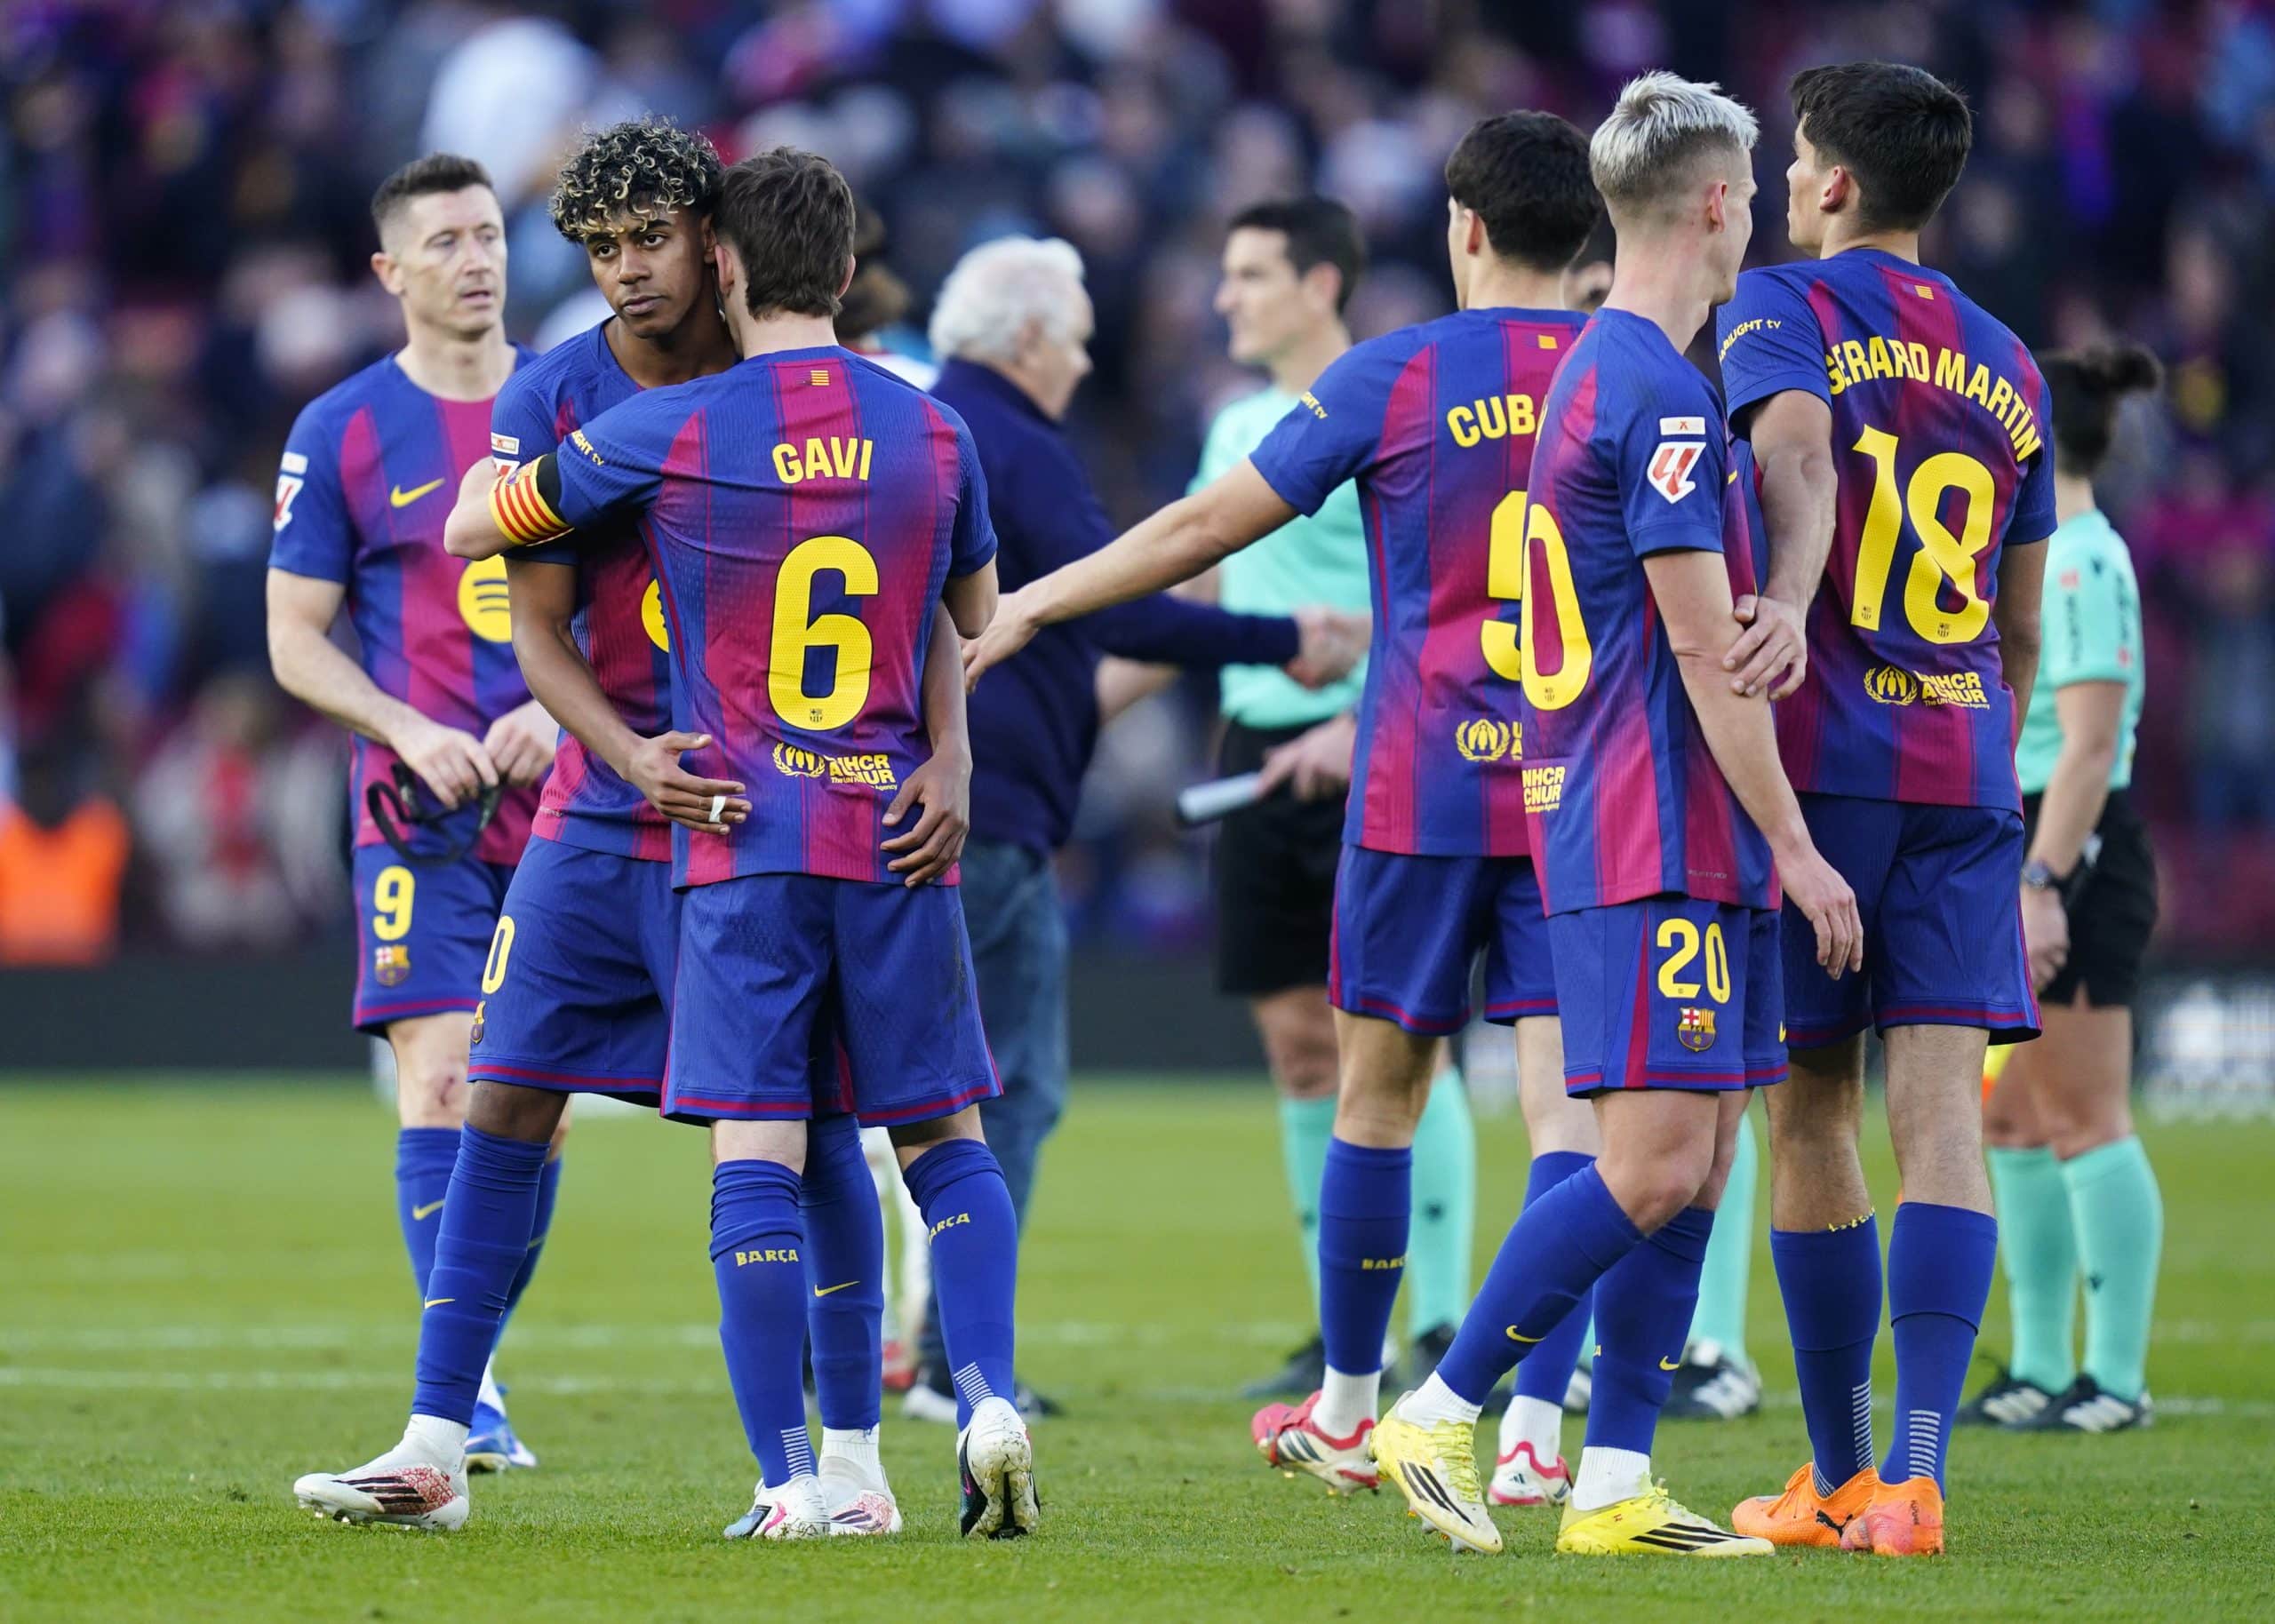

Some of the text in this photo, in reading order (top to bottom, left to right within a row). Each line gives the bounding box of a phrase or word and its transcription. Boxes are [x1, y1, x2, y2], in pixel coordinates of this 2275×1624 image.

[1766, 318, 1782, 330] tv
[1825, 335, 1931, 395] GERARD
[1446, 394, 1548, 448] CUB
[771, 436, 874, 484] GAVI
[1849, 423, 1996, 645] 18
[767, 535, 880, 731] 6
[372, 865, 416, 941] 9
[481, 914, 515, 995] 0
[1656, 918, 1731, 1004] 20
[734, 1248, 799, 1267] BARÇA
